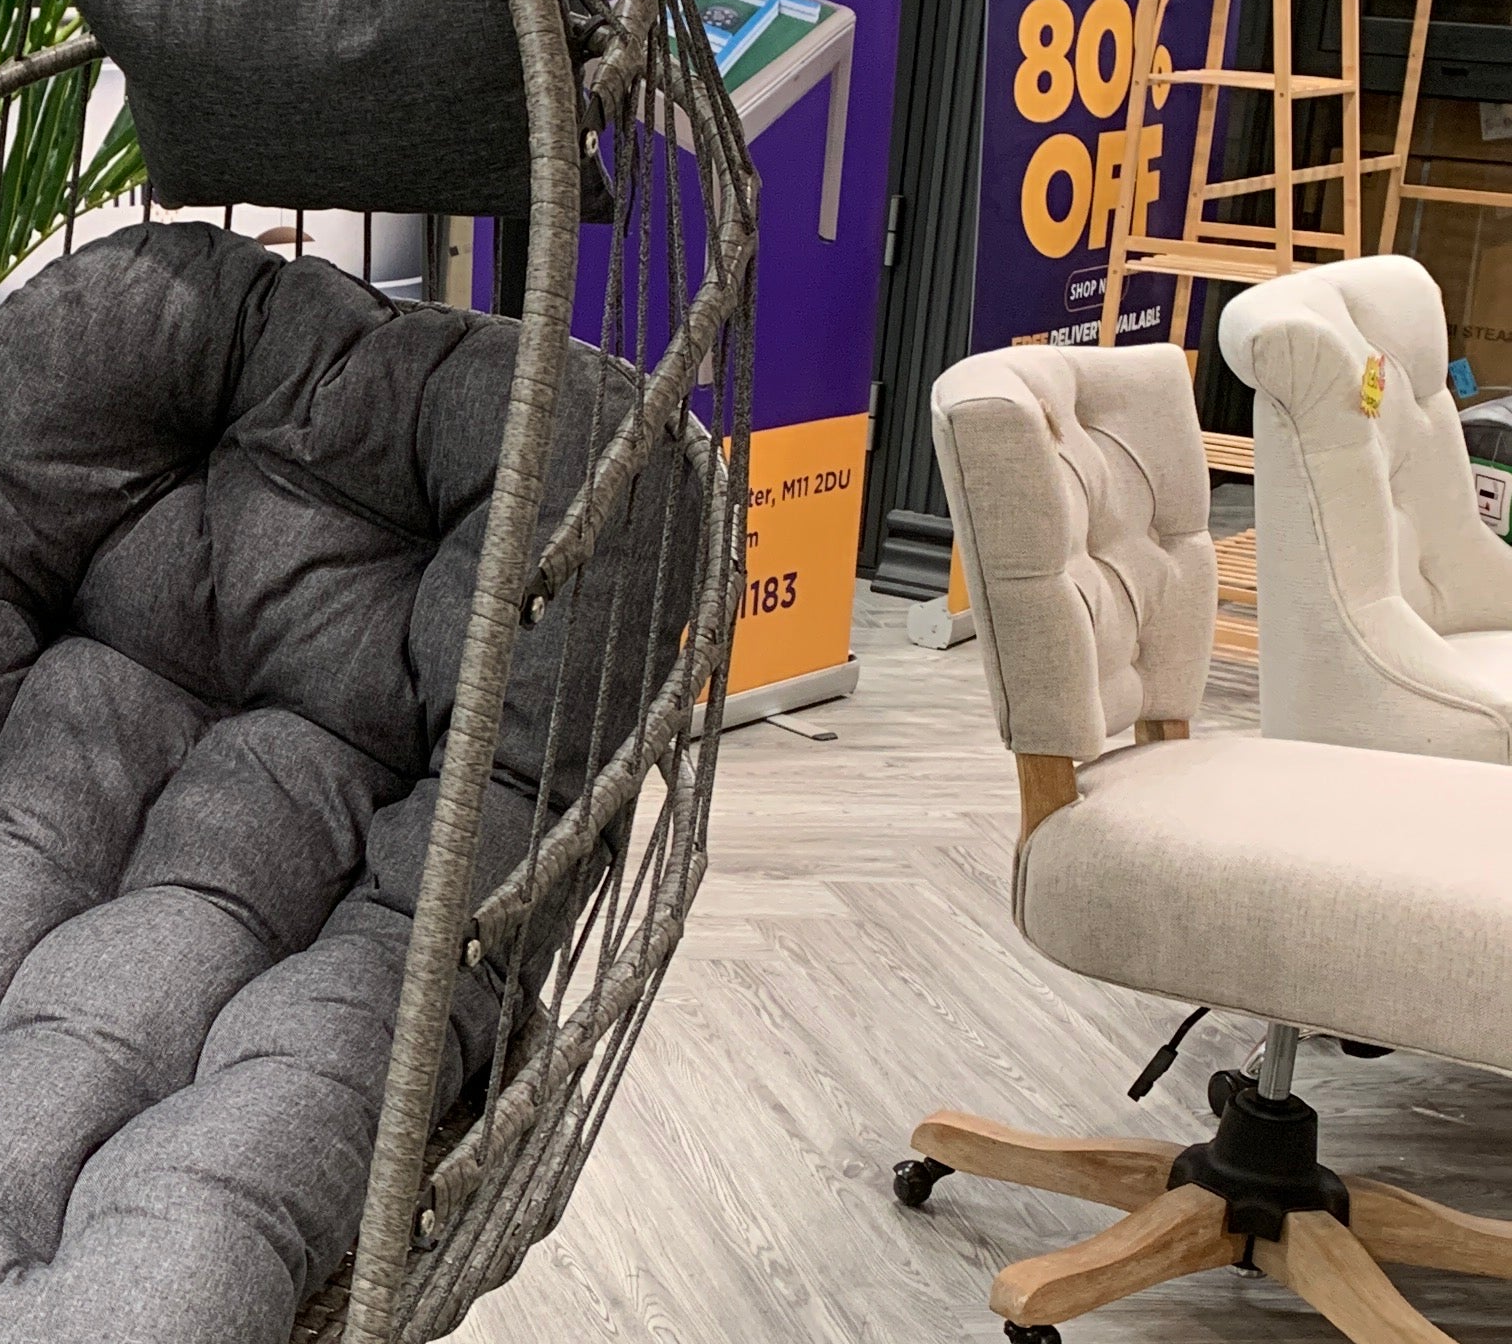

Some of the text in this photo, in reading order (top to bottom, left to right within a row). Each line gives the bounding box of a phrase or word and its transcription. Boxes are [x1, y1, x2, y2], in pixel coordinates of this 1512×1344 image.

[1021, 123, 1164, 259] OFF
[1069, 280, 1097, 301] SHOP
[782, 475, 810, 502] M11
[814, 468, 851, 495] 2DU
